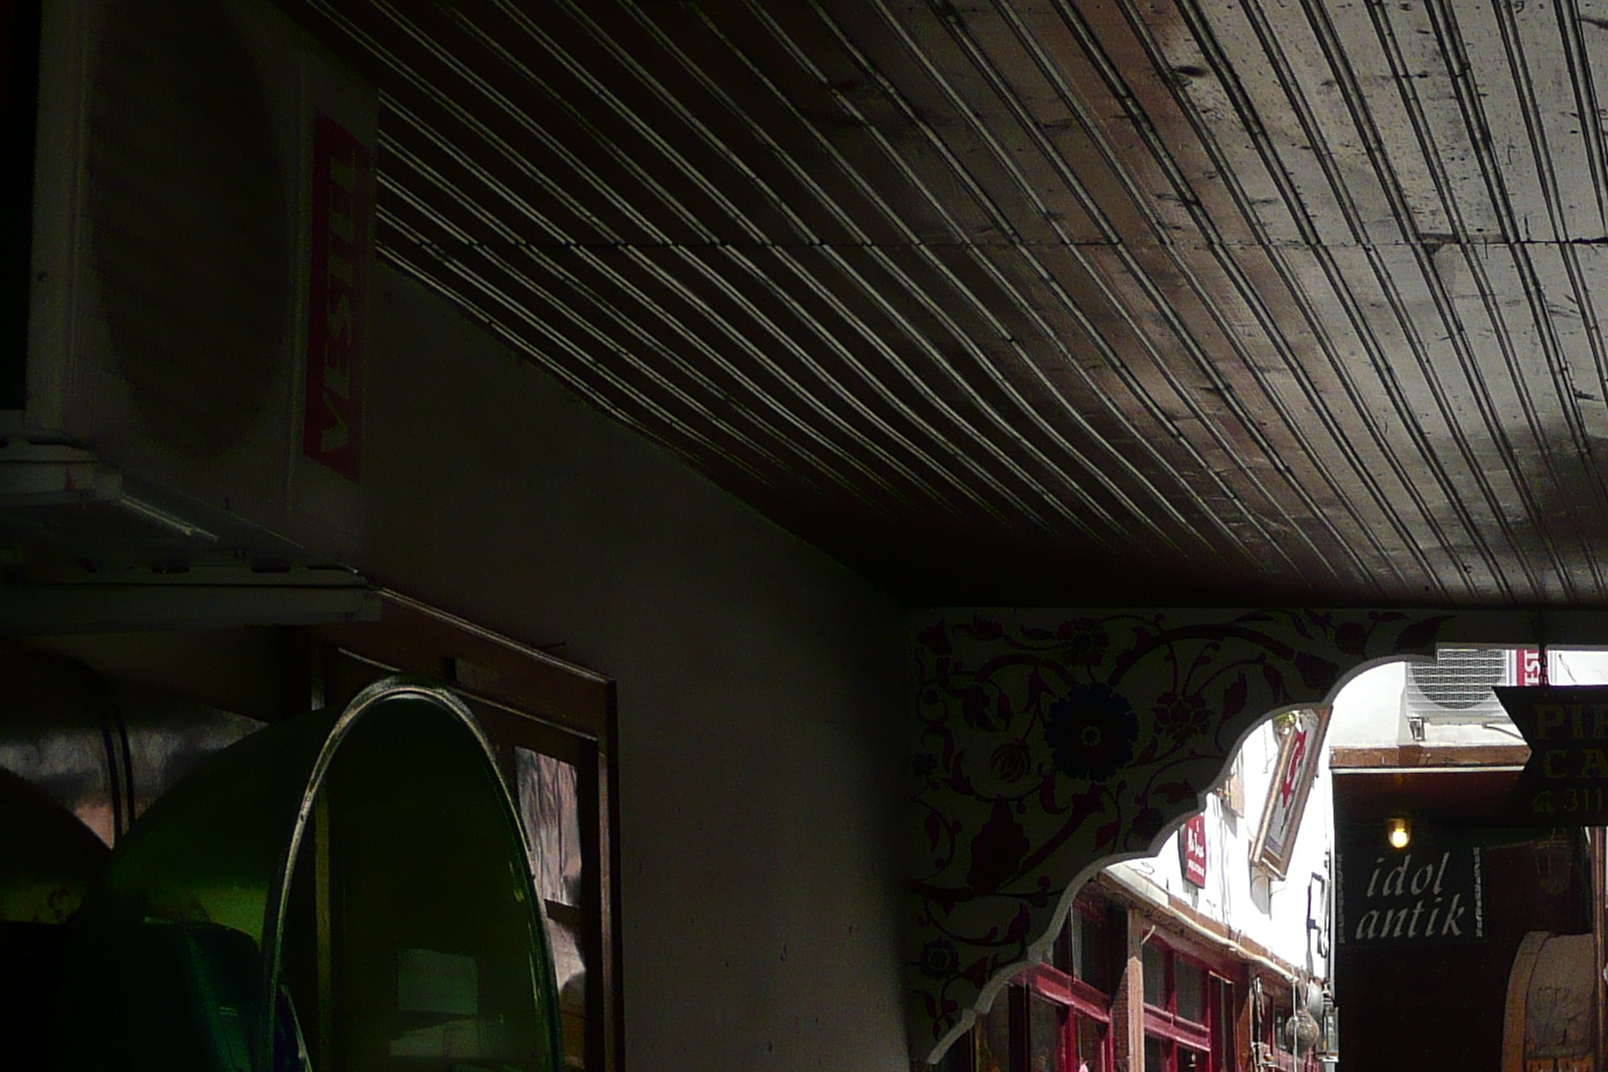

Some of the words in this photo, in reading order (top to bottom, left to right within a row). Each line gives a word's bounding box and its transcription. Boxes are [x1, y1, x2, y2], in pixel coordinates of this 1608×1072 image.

[319, 147, 358, 455] VESTEL
[1563, 786, 1604, 813] 311
[1366, 851, 1451, 898] idol
[1355, 893, 1466, 941] antik
